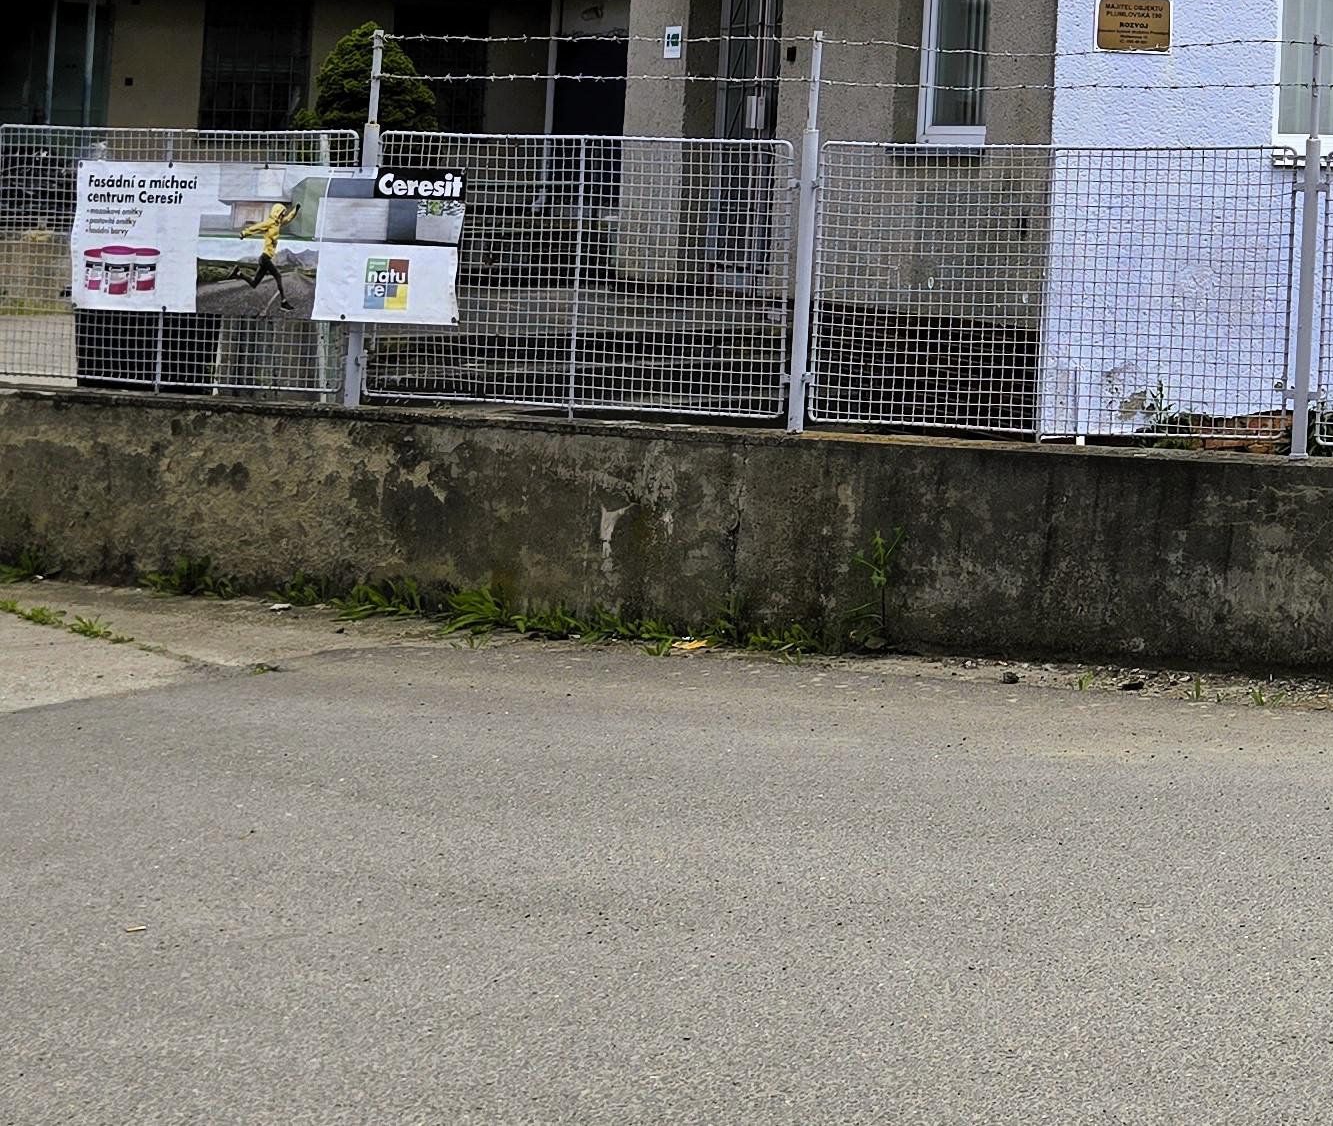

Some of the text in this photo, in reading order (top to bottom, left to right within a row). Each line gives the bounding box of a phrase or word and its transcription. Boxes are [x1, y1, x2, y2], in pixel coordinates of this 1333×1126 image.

[1120, 21, 1149, 29] ROZVOJ
[88, 174, 198, 190] Fasádní a míchací
[378, 172, 463, 197] Ceresit
[88, 190, 184, 205] centrum Ceresit
[366, 268, 406, 284] natu
[367, 284, 385, 297] re
